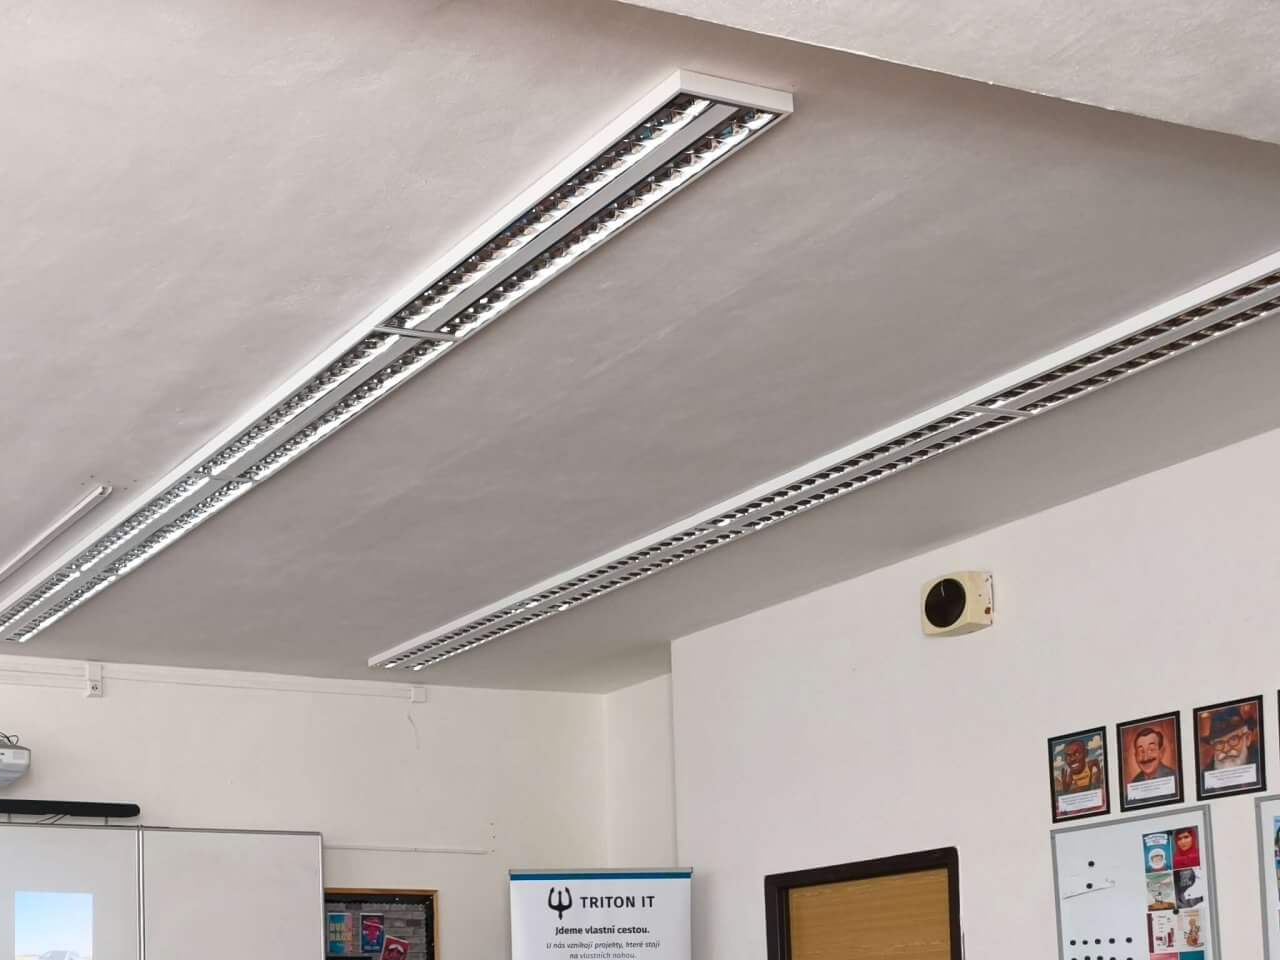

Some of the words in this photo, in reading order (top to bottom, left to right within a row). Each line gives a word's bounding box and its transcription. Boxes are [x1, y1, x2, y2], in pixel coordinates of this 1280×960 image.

[579, 896, 636, 909] TRITON
[641, 895, 656, 908] IT
[555, 926, 583, 936] Jdeme
[585, 925, 615, 934] vlastní
[617, 926, 650, 934] cestou.
